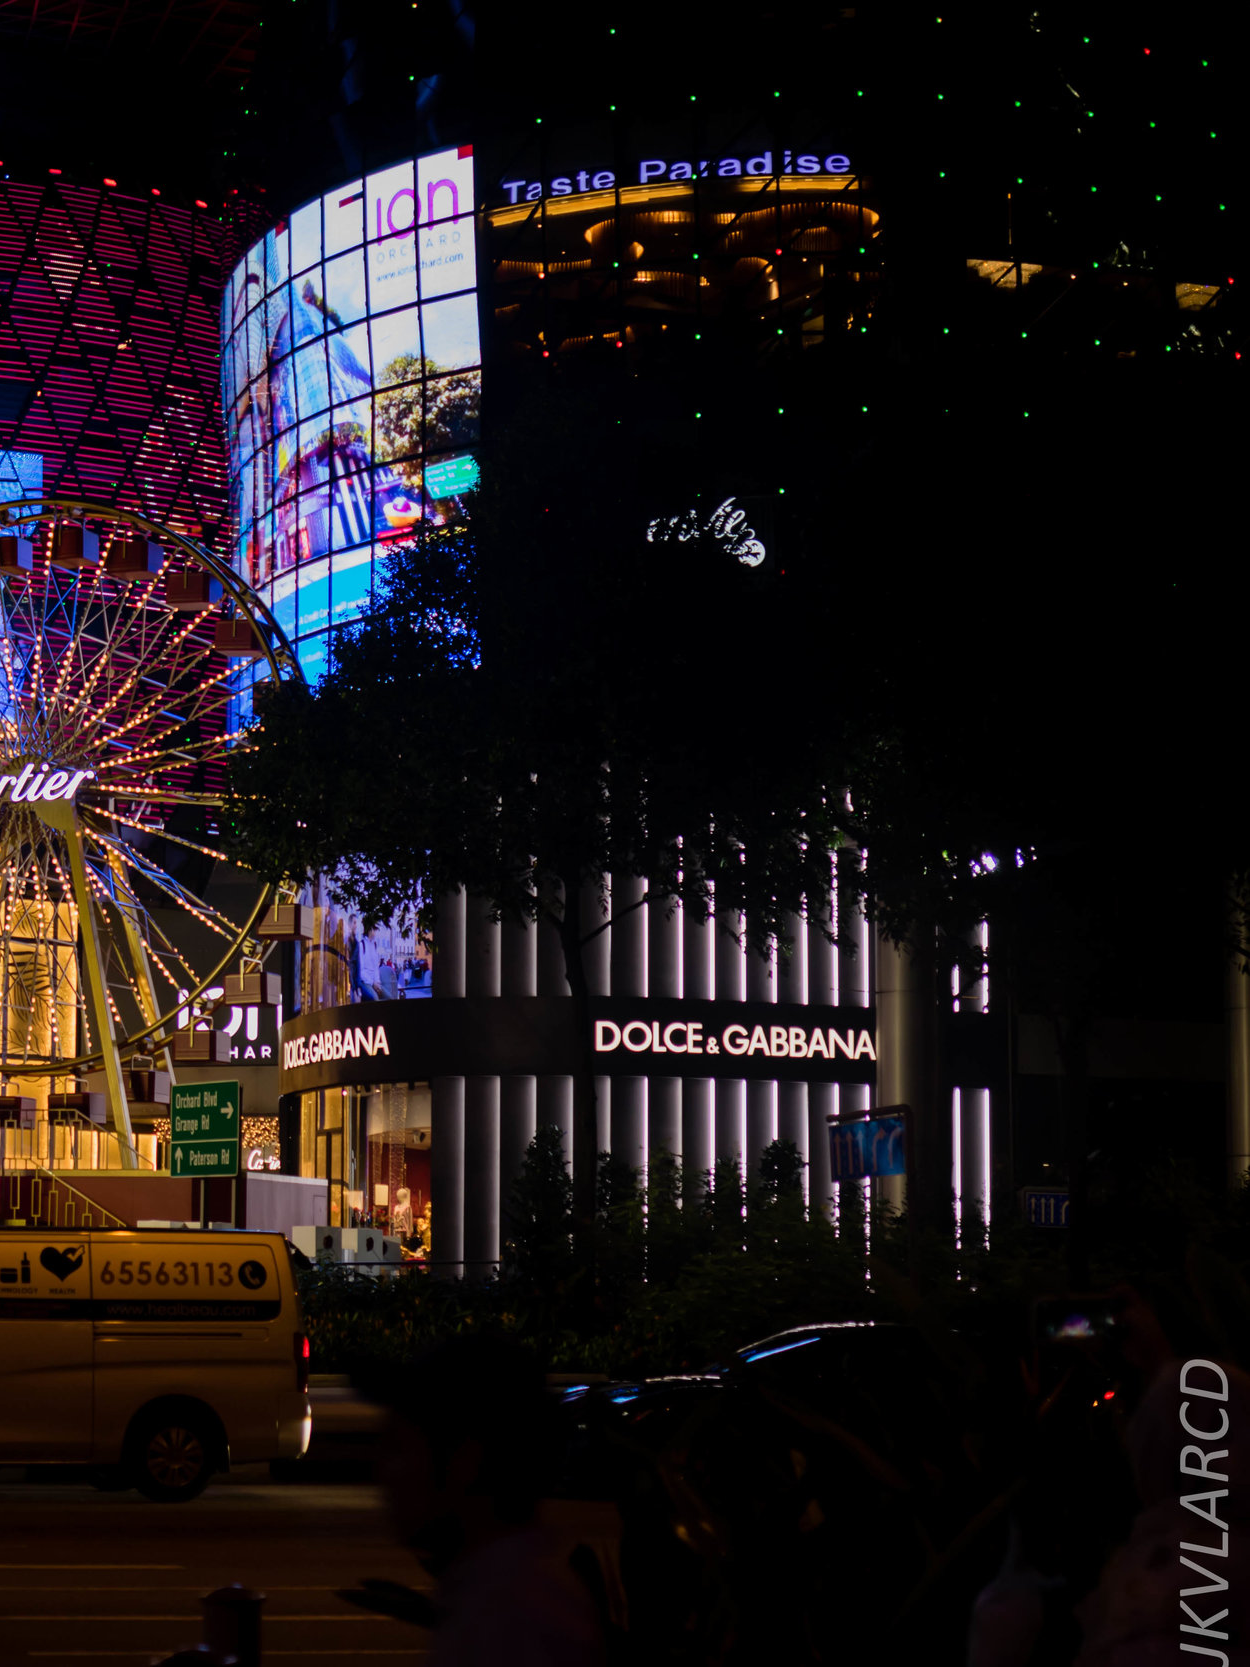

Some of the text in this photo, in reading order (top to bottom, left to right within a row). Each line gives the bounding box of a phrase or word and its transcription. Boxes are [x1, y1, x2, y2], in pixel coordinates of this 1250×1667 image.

[502, 150, 851, 204] Taste Paradise
[376, 231, 461, 264] ORCARD
[175, 1090, 218, 1109] Orchard Blvd
[175, 1114, 210, 1135] Grange Rd
[190, 1148, 230, 1166] Paterson Rd
[100, 1260, 234, 1286] 65563113
[105, 1302, 257, 1318] www.healbeau.com
